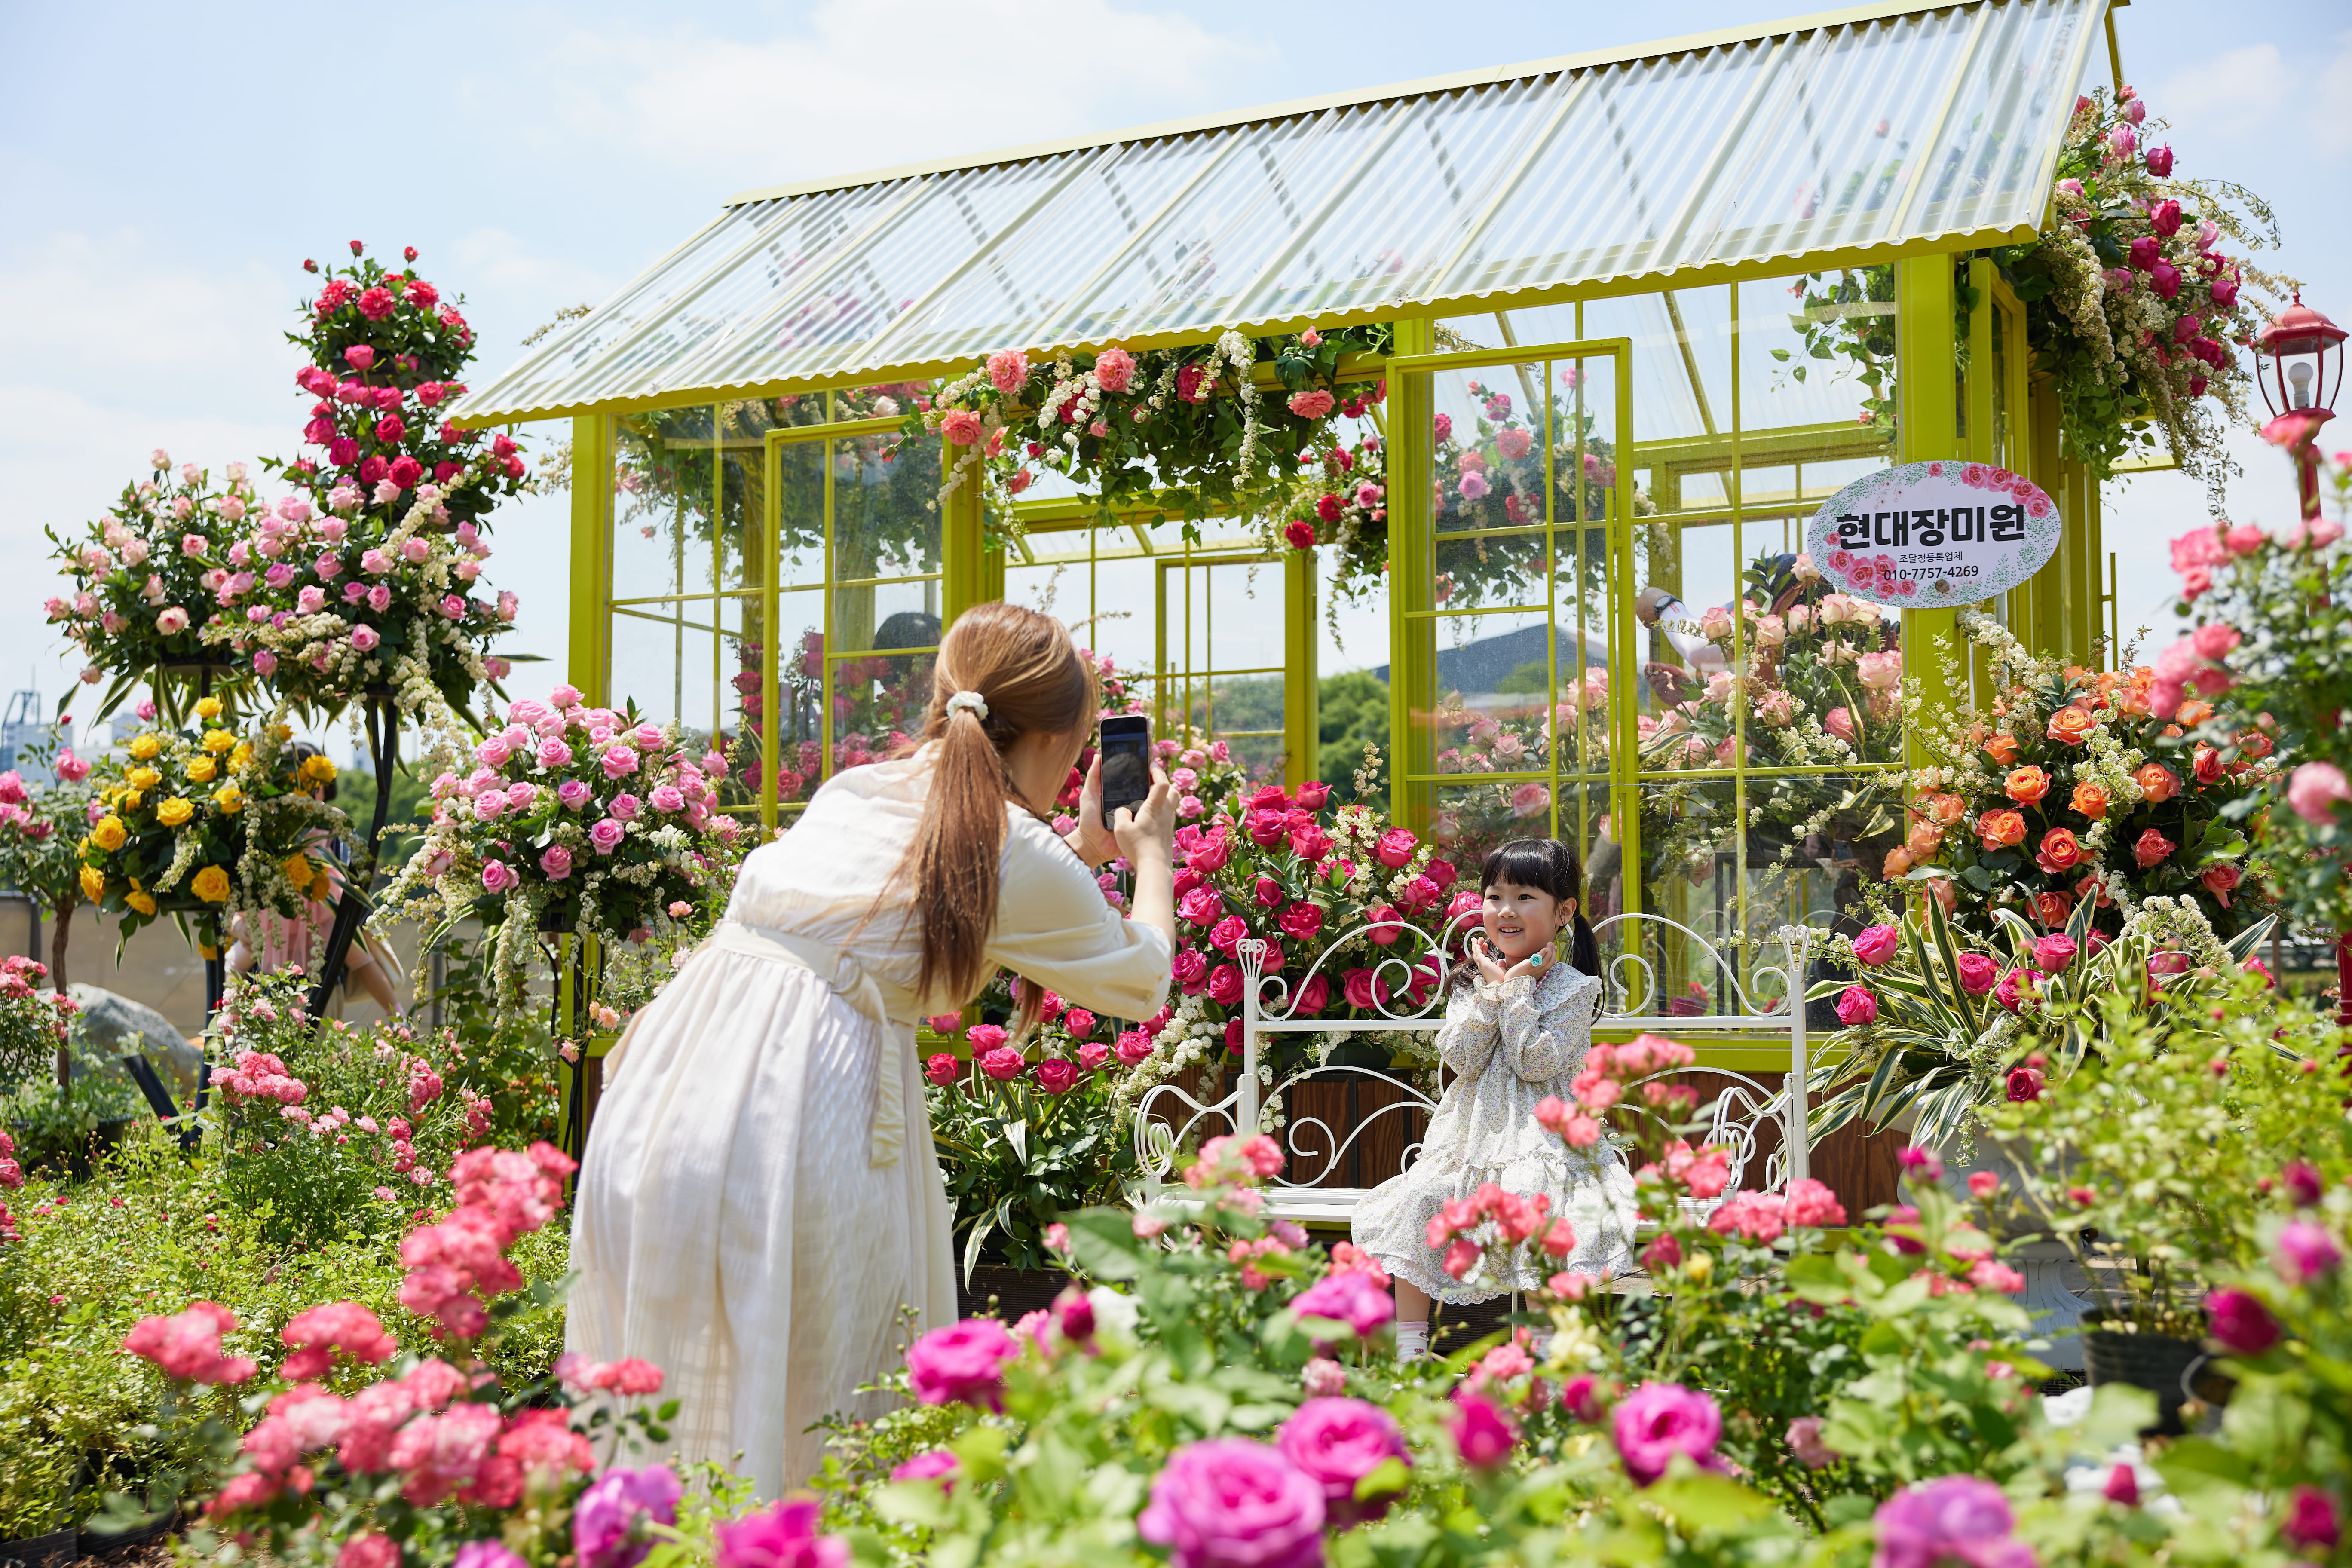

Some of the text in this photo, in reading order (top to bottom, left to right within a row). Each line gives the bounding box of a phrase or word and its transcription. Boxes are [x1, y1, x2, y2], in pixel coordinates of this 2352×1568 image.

[1837, 504, 2025, 550] 현대장미원
[1899, 551, 1963, 563] 조달청등록업체
[1884, 565, 1978, 581] 010-7757-4269
